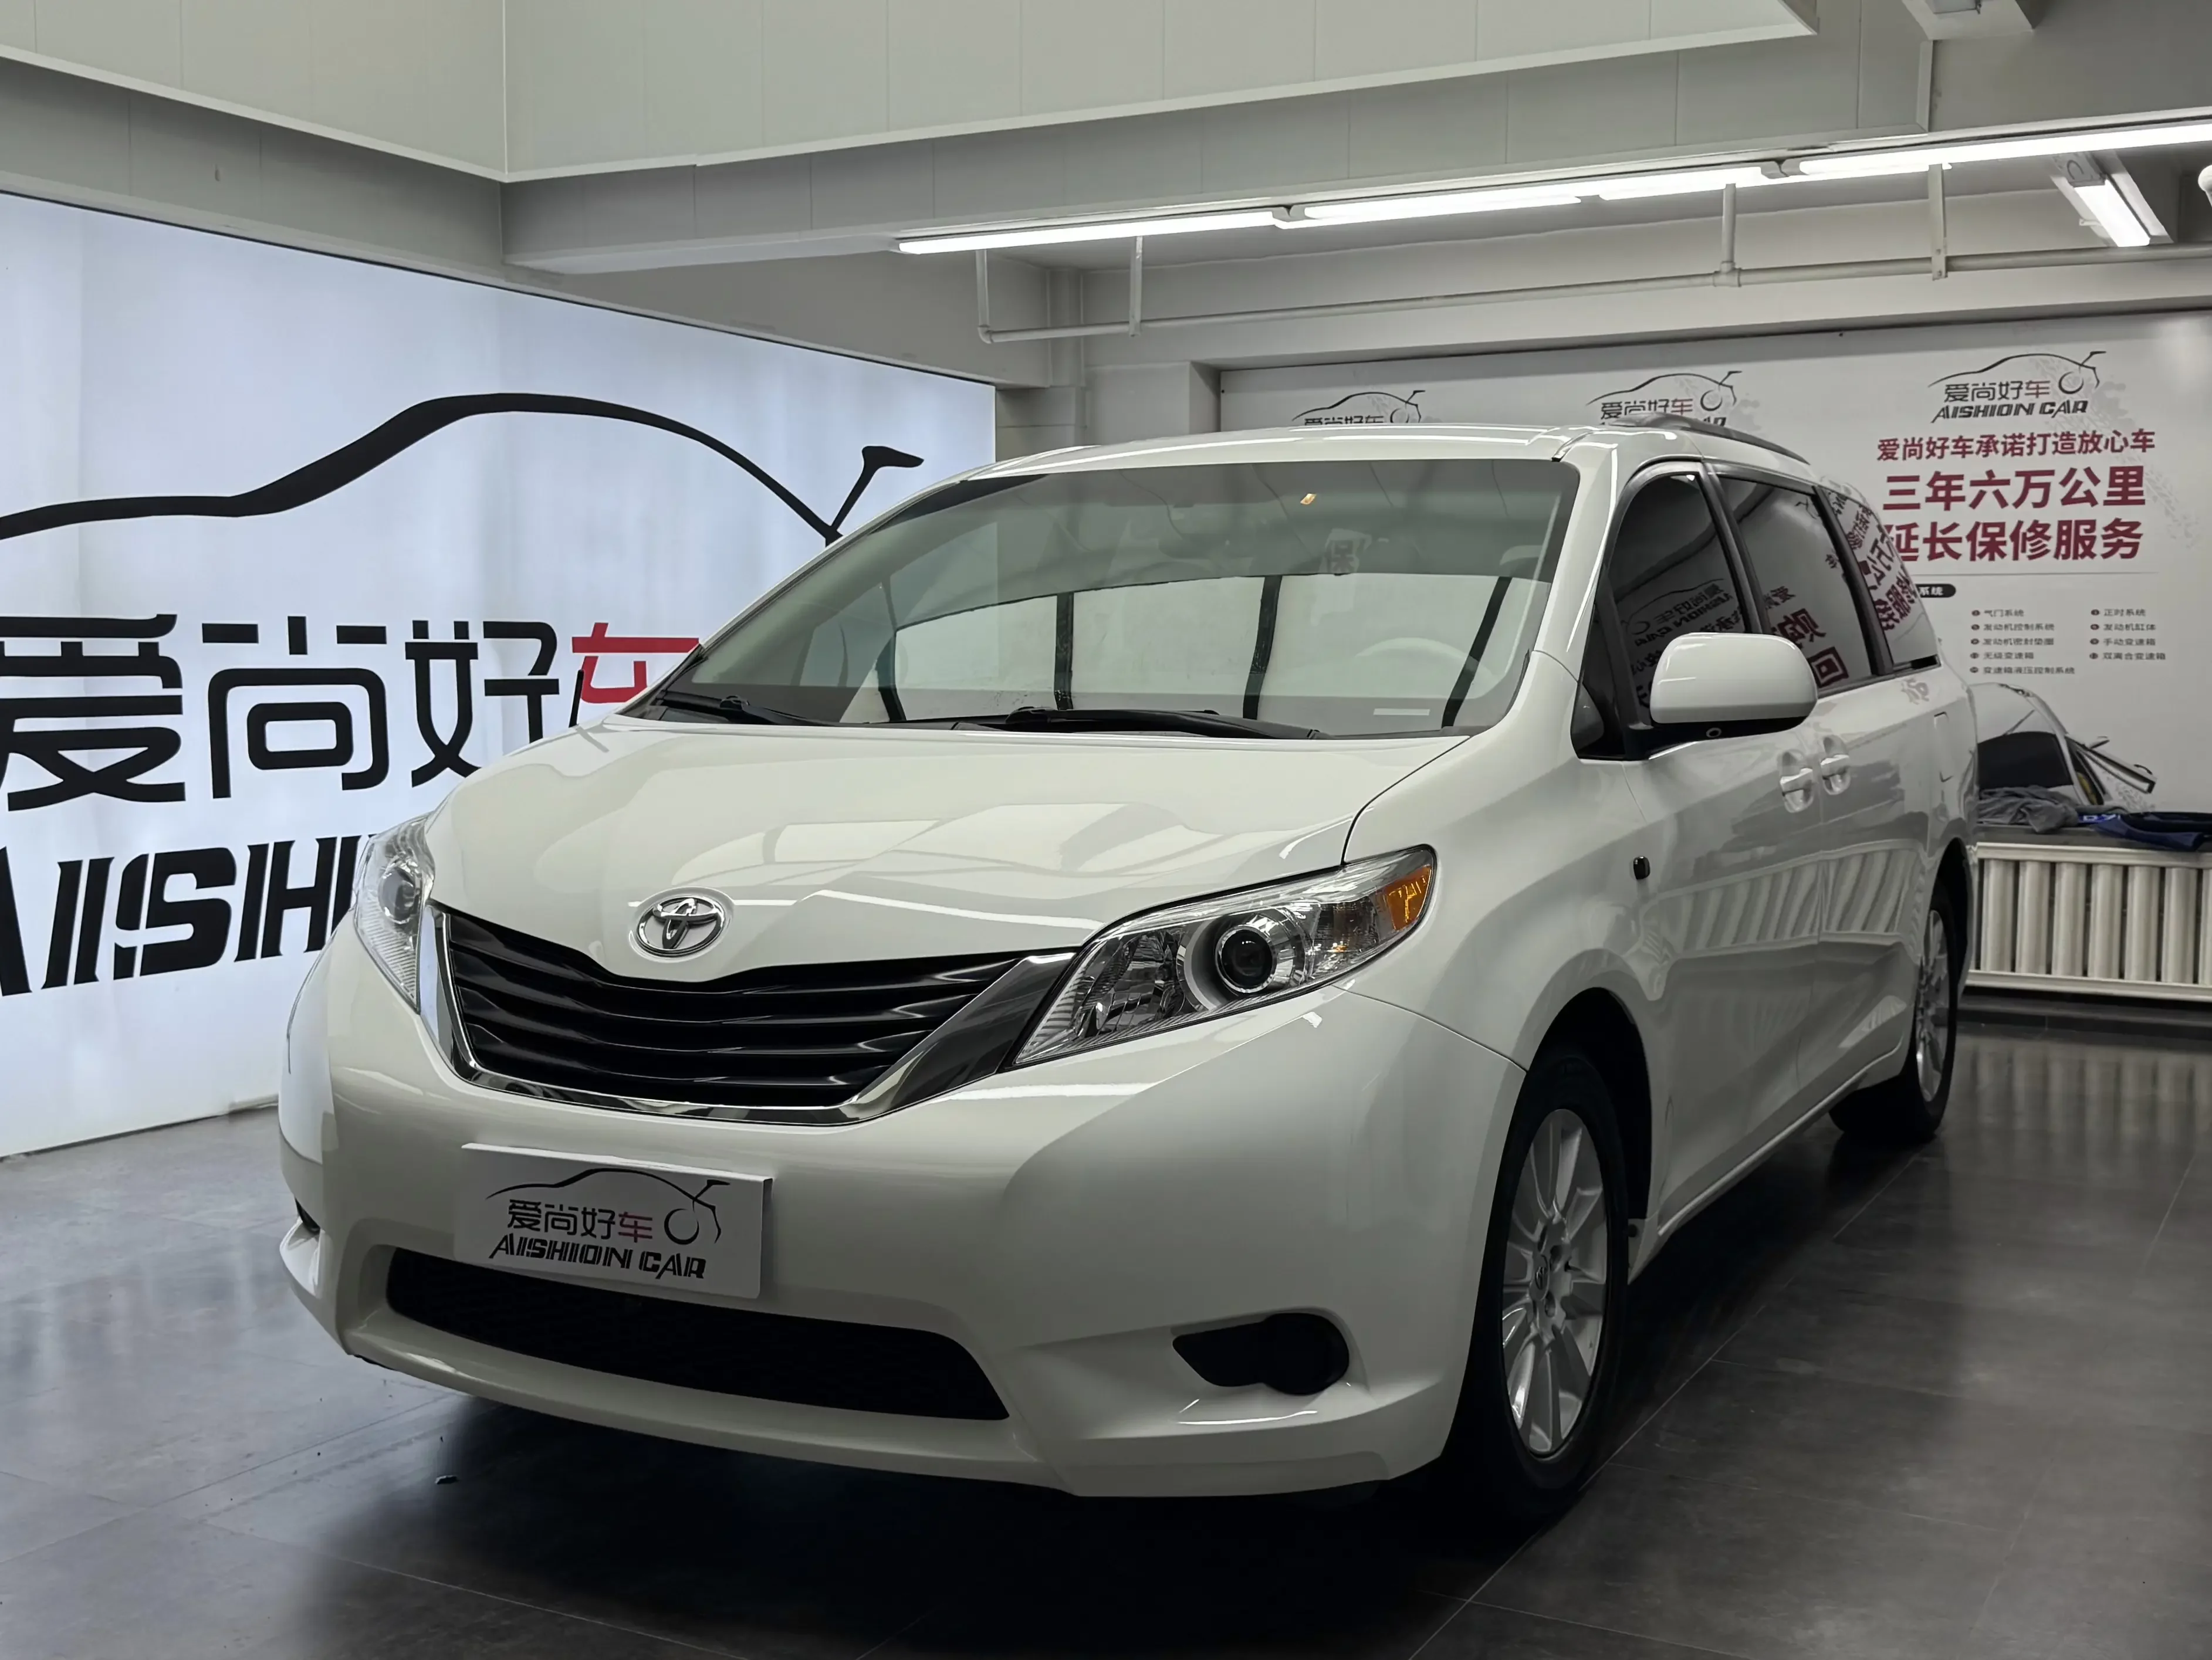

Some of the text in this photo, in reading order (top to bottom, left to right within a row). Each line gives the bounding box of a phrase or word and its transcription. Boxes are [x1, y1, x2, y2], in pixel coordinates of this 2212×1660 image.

[1930, 399, 2089, 424] AISHION CAR
[1943, 380, 2051, 404] 爱尚好车
[1876, 428, 2156, 461] 爱尚好车承诺打造放心车
[1882, 465, 2146, 511] 三年六万公里
[1883, 517, 2145, 563] 延长保修服务
[507, 1198, 653, 1243] 爱尚好车
[488, 1232, 706, 1279] AISHION CAR
